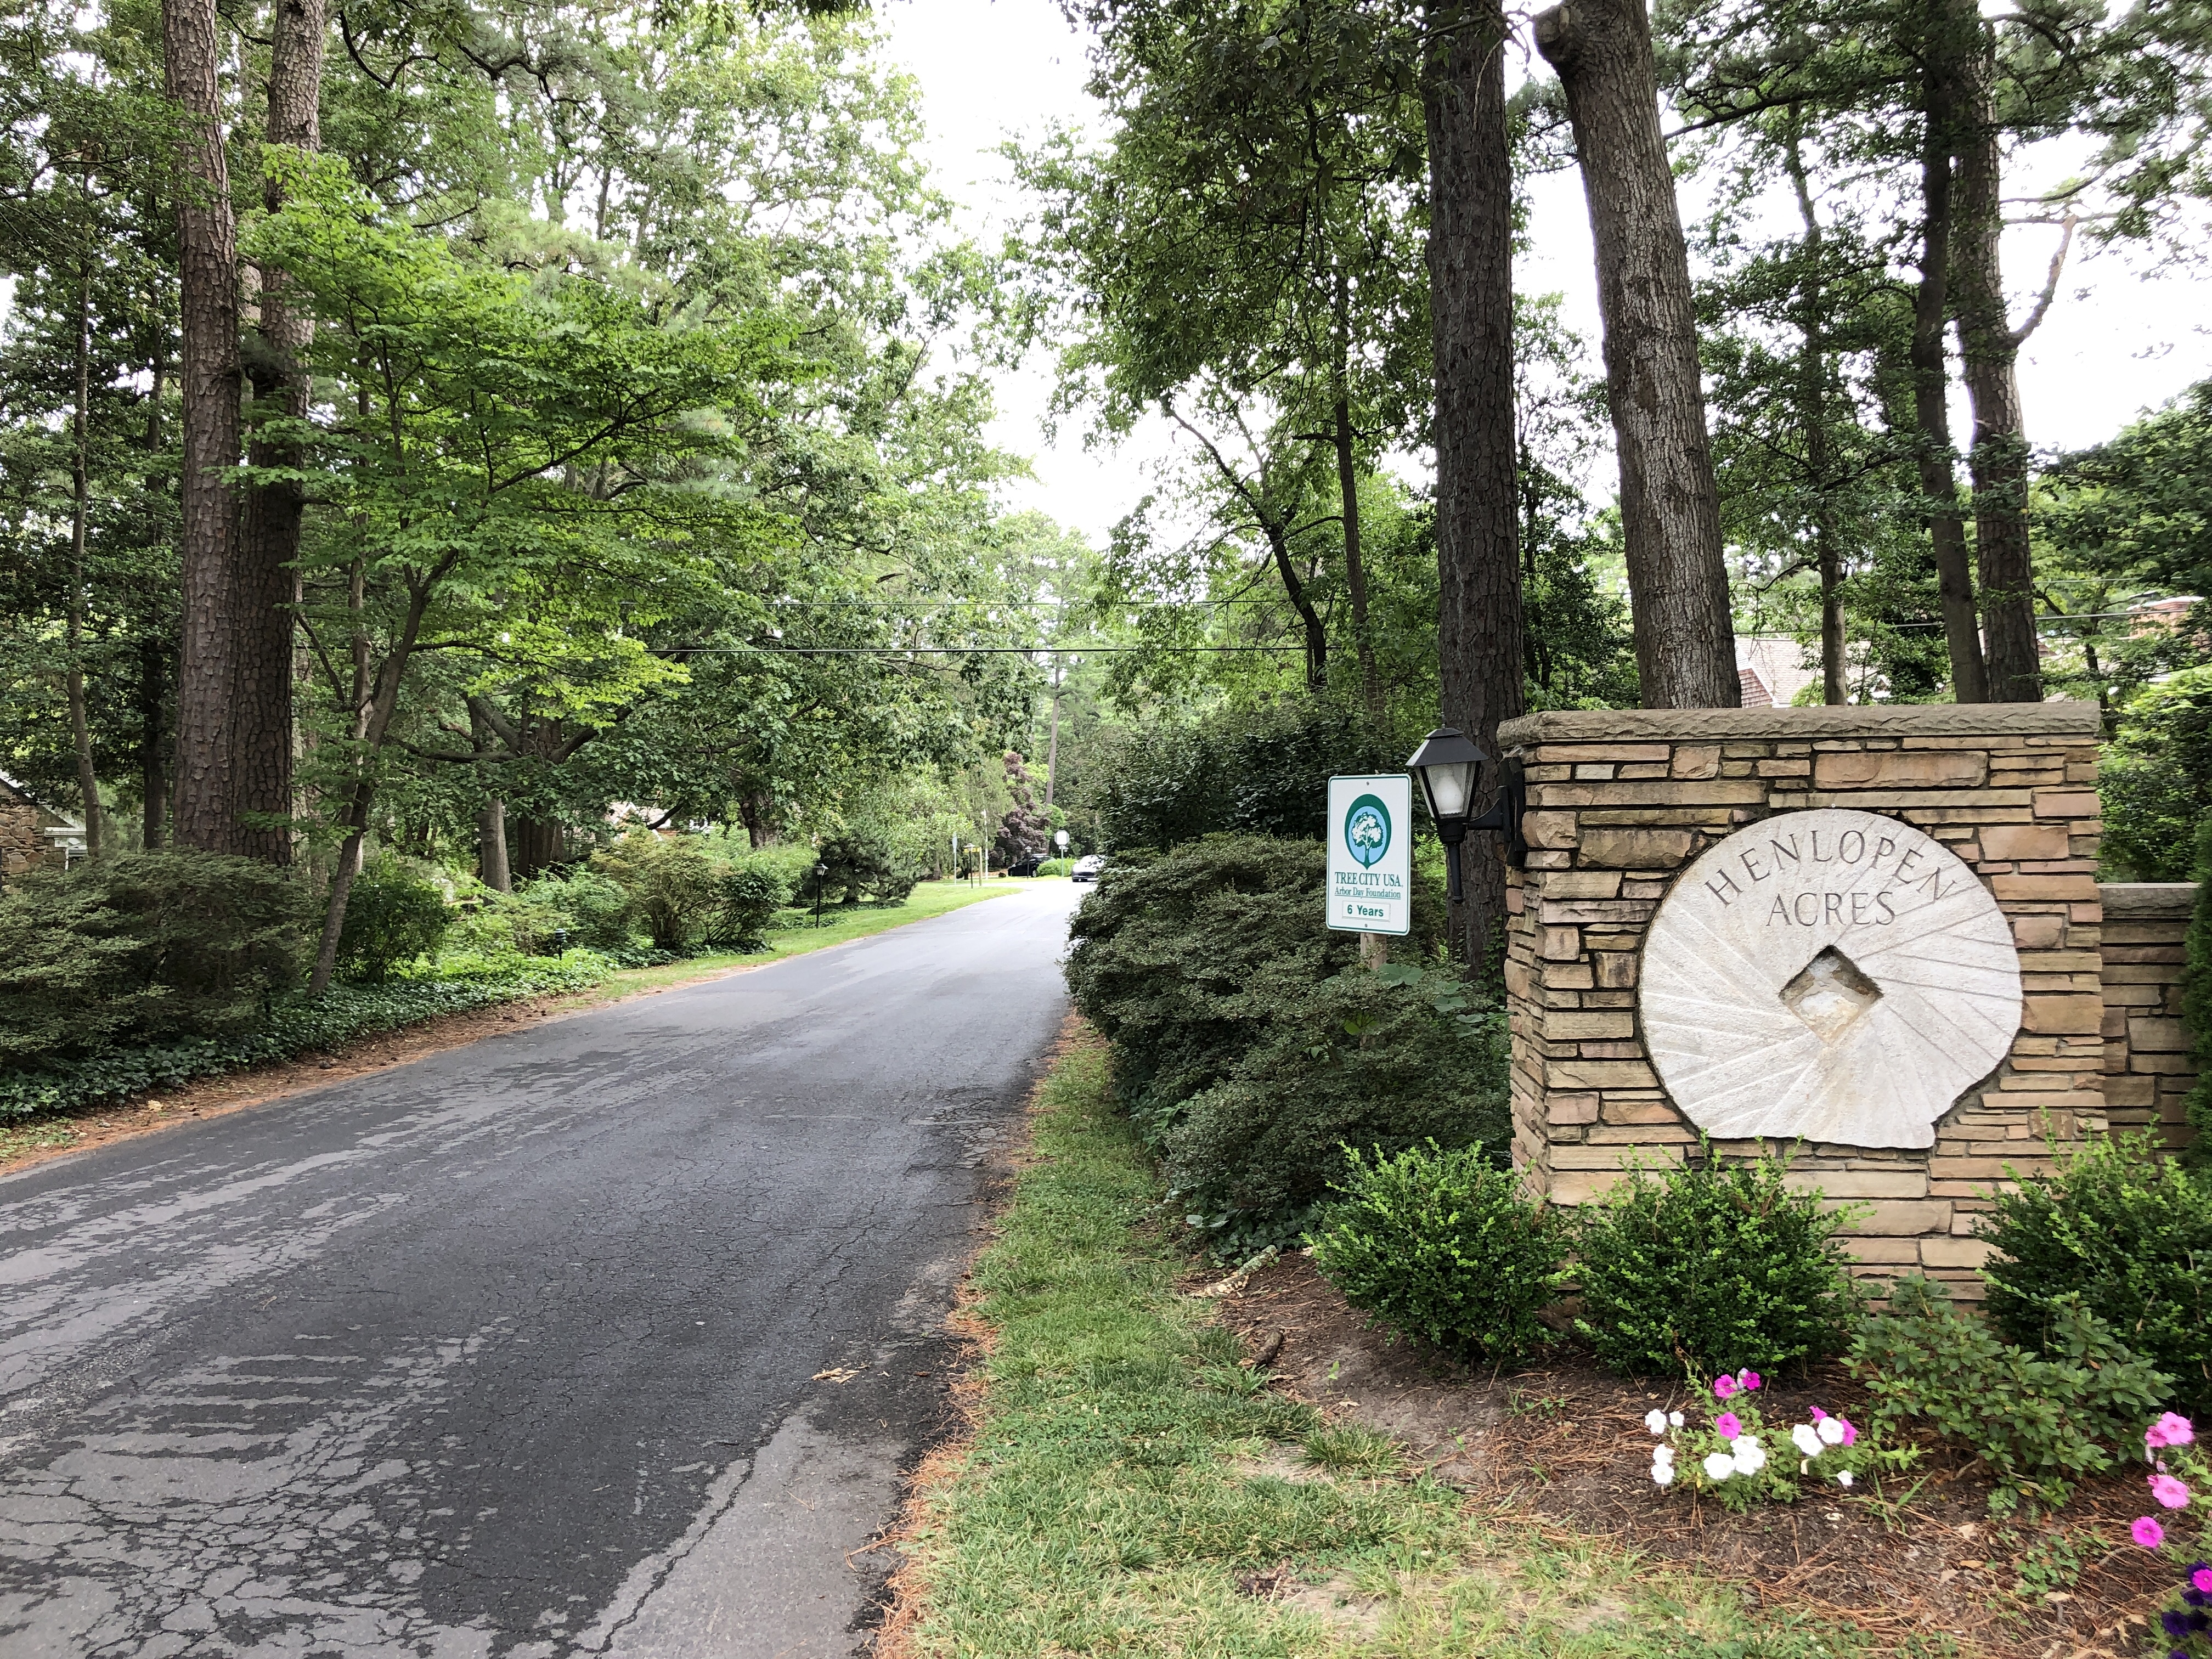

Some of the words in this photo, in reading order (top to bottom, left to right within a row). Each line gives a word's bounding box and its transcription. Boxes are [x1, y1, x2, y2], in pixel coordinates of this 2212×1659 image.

[1704, 830, 1957, 907] HENLOPEN
[1334, 872, 1358, 884] TREE
[1359, 873, 1381, 885] CITY
[1334, 886, 1351, 895] Arbor
[1353, 887, 1364, 899] Day
[1365, 888, 1401, 898] Foundation
[1347, 904, 1353, 915] 6
[1357, 905, 1384, 917] Years
[1766, 891, 1895, 927] ACRES
